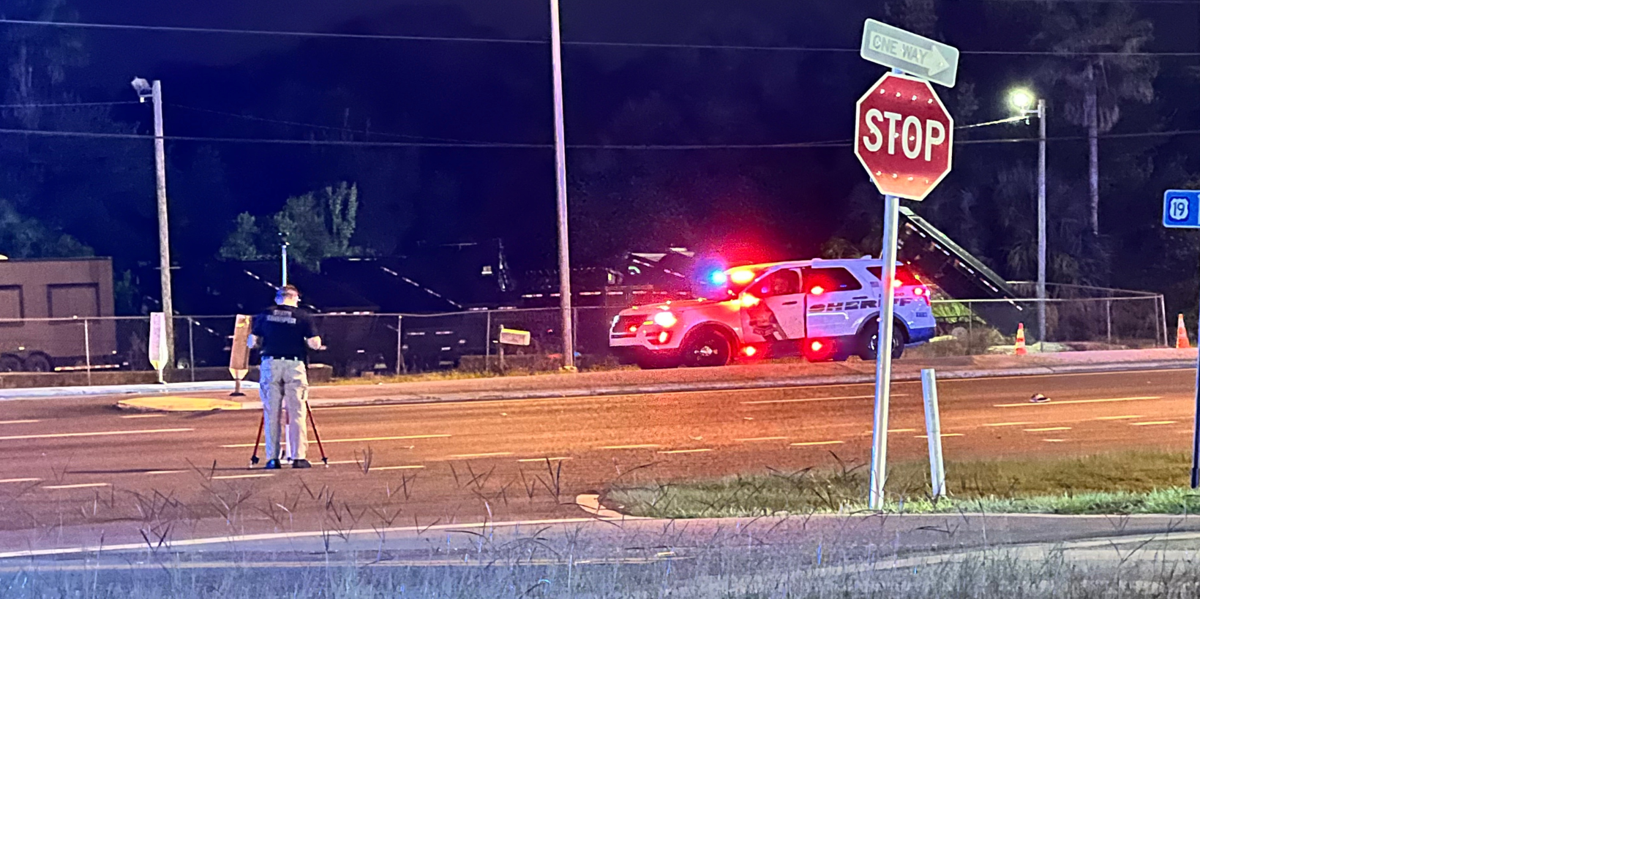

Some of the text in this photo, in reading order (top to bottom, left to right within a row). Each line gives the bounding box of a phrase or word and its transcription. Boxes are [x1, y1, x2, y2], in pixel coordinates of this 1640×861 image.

[873, 35, 928, 64] ONE WAY
[863, 108, 945, 161] STOP
[1173, 201, 1185, 216] 19
